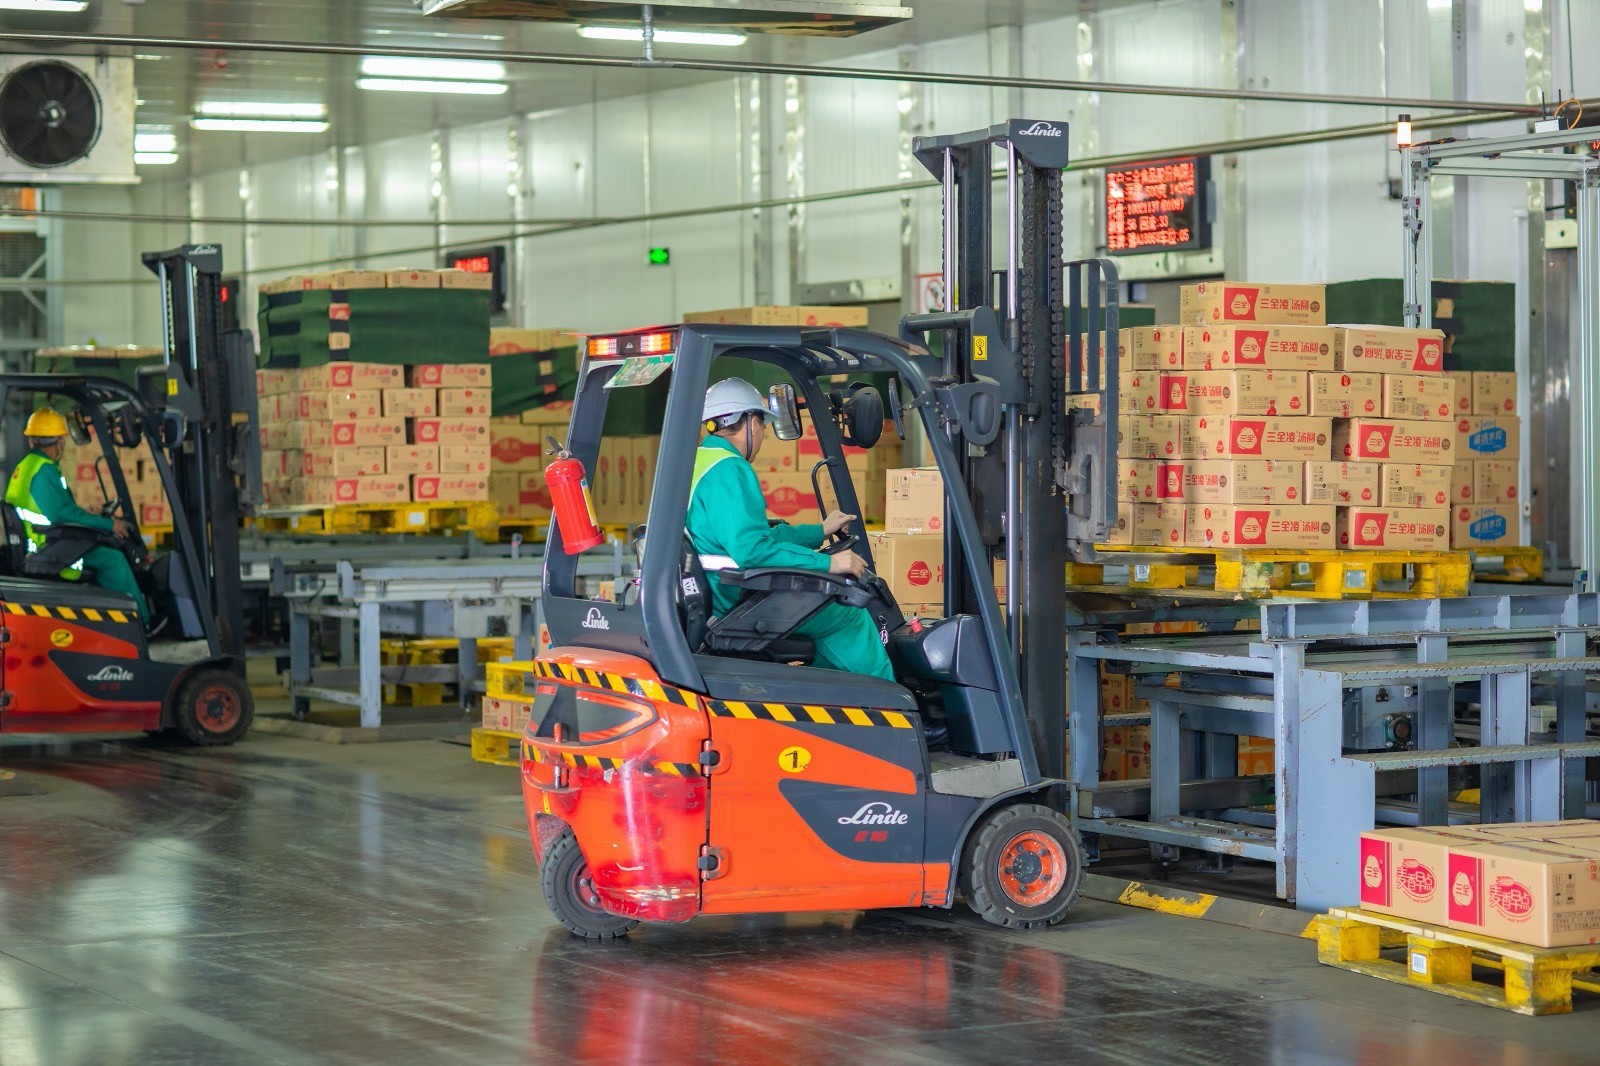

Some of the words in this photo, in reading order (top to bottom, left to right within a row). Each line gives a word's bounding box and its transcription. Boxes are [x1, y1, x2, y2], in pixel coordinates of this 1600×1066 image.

[1018, 121, 1062, 138] Linde
[1233, 300, 1248, 309] 三全
[1243, 344, 1258, 352] 三全
[1239, 434, 1255, 443] 三全
[1369, 438, 1383, 447] 三全
[1244, 524, 1259, 533] 三全
[1363, 526, 1378, 534] 三全
[910, 569, 928, 579] 三全
[581, 607, 610, 630] Linde
[54, 632, 70, 644] 2
[87, 664, 134, 681] Linde
[785, 750, 798, 769] 1
[837, 801, 909, 825] Linde
[1366, 866, 1379, 879] 三全
[1396, 866, 1433, 892] 麦香早点
[1455, 883, 1470, 897] 三全
[1489, 884, 1531, 911] 麦香早点
